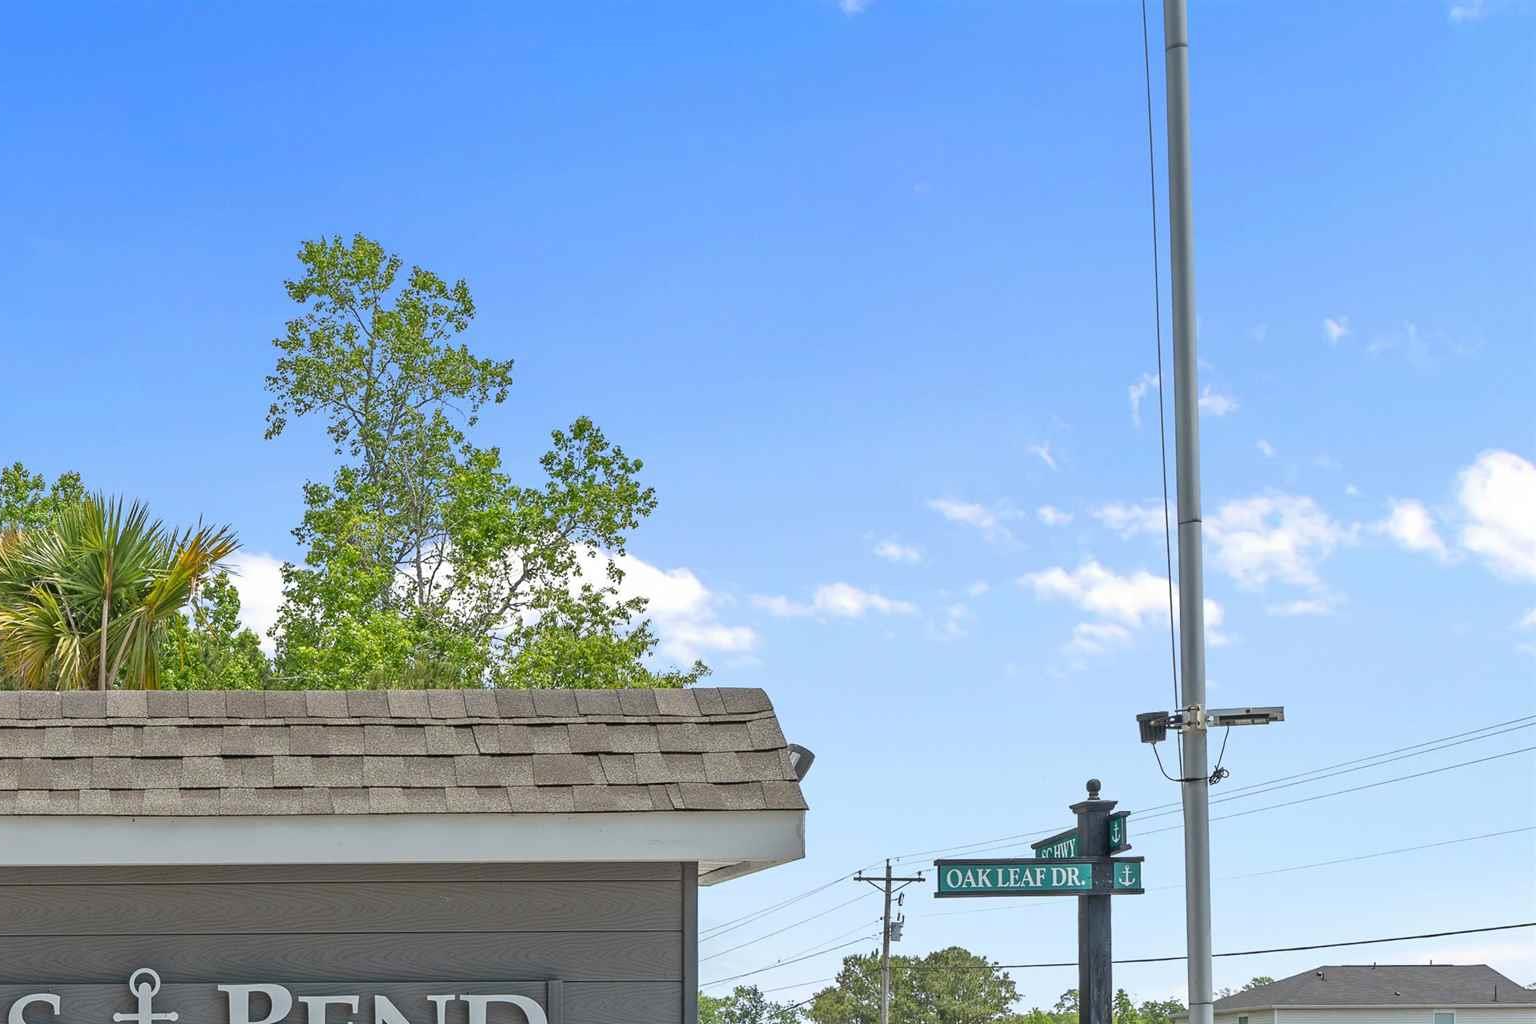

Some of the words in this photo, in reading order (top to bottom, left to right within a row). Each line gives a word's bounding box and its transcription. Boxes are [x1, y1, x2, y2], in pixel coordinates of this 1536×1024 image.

[1054, 838, 1076, 858] HWY
[946, 868, 993, 889] OAK
[996, 867, 1046, 888] LEAF
[1050, 866, 1086, 887] DR.
